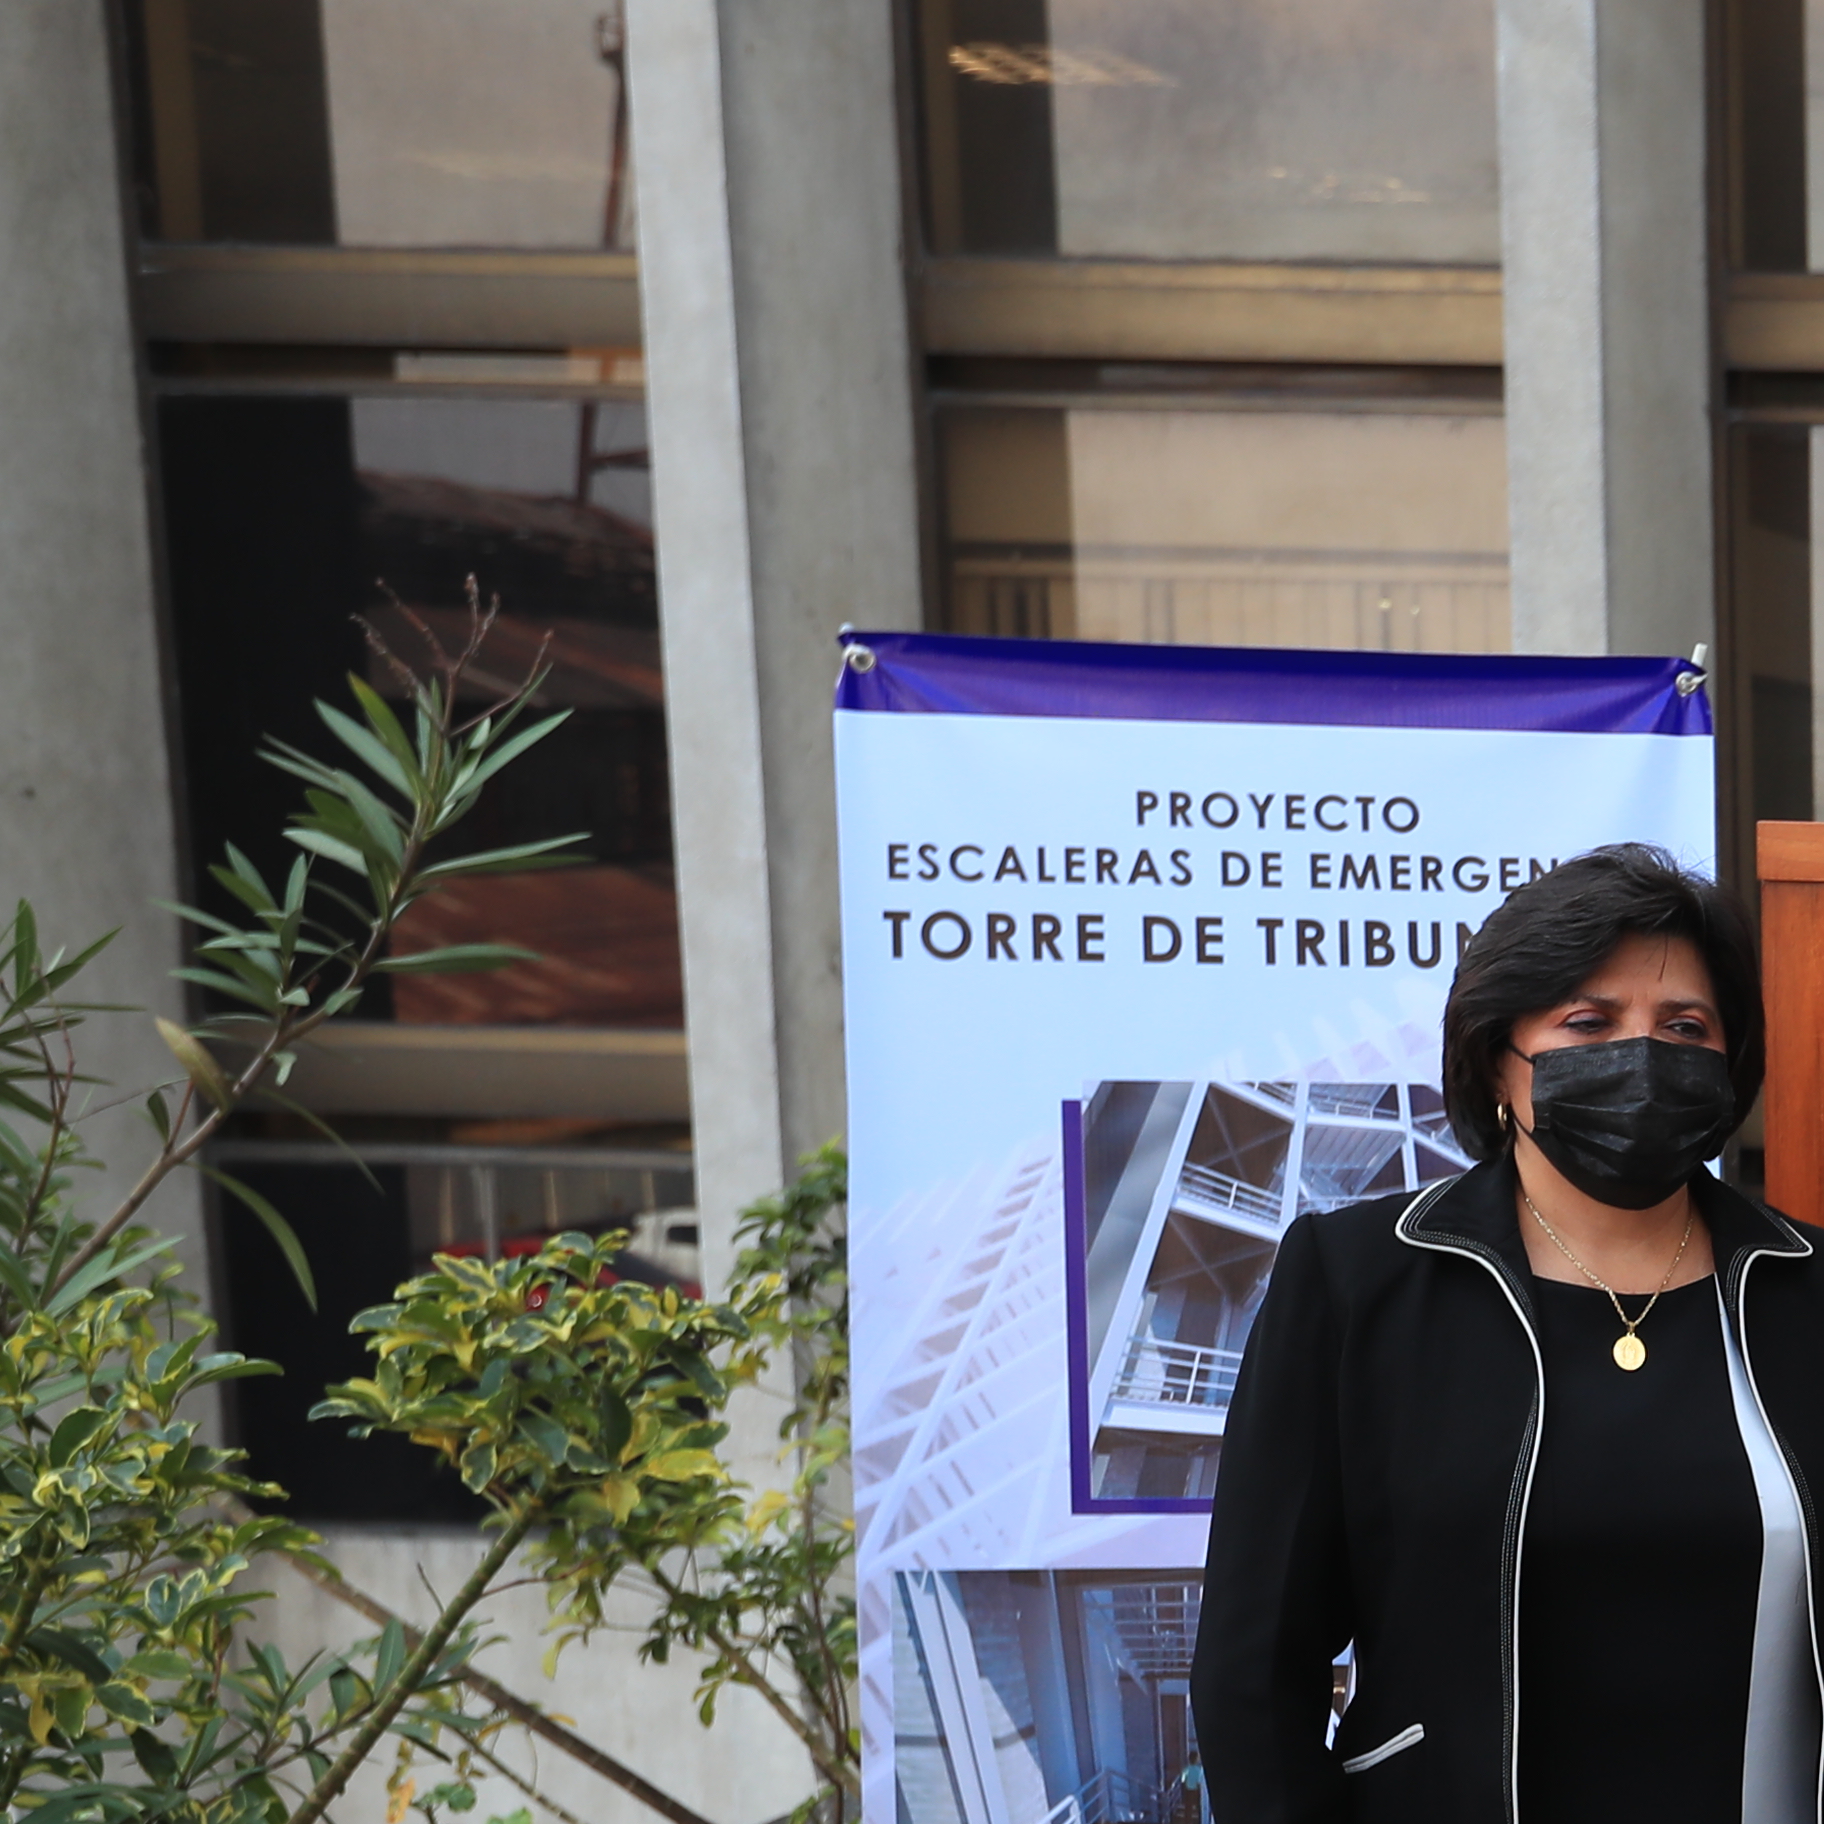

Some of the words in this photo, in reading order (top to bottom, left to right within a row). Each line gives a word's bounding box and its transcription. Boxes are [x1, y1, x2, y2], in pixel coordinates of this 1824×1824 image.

[1136, 791, 1421, 833] PROYECTO
[887, 843, 1193, 886] ESCALERAS
[1221, 850, 1283, 888] DE
[1310, 854, 1559, 893] EMERGEN
[883, 910, 1105, 962] TORRE
[1144, 915, 1225, 966] DE
